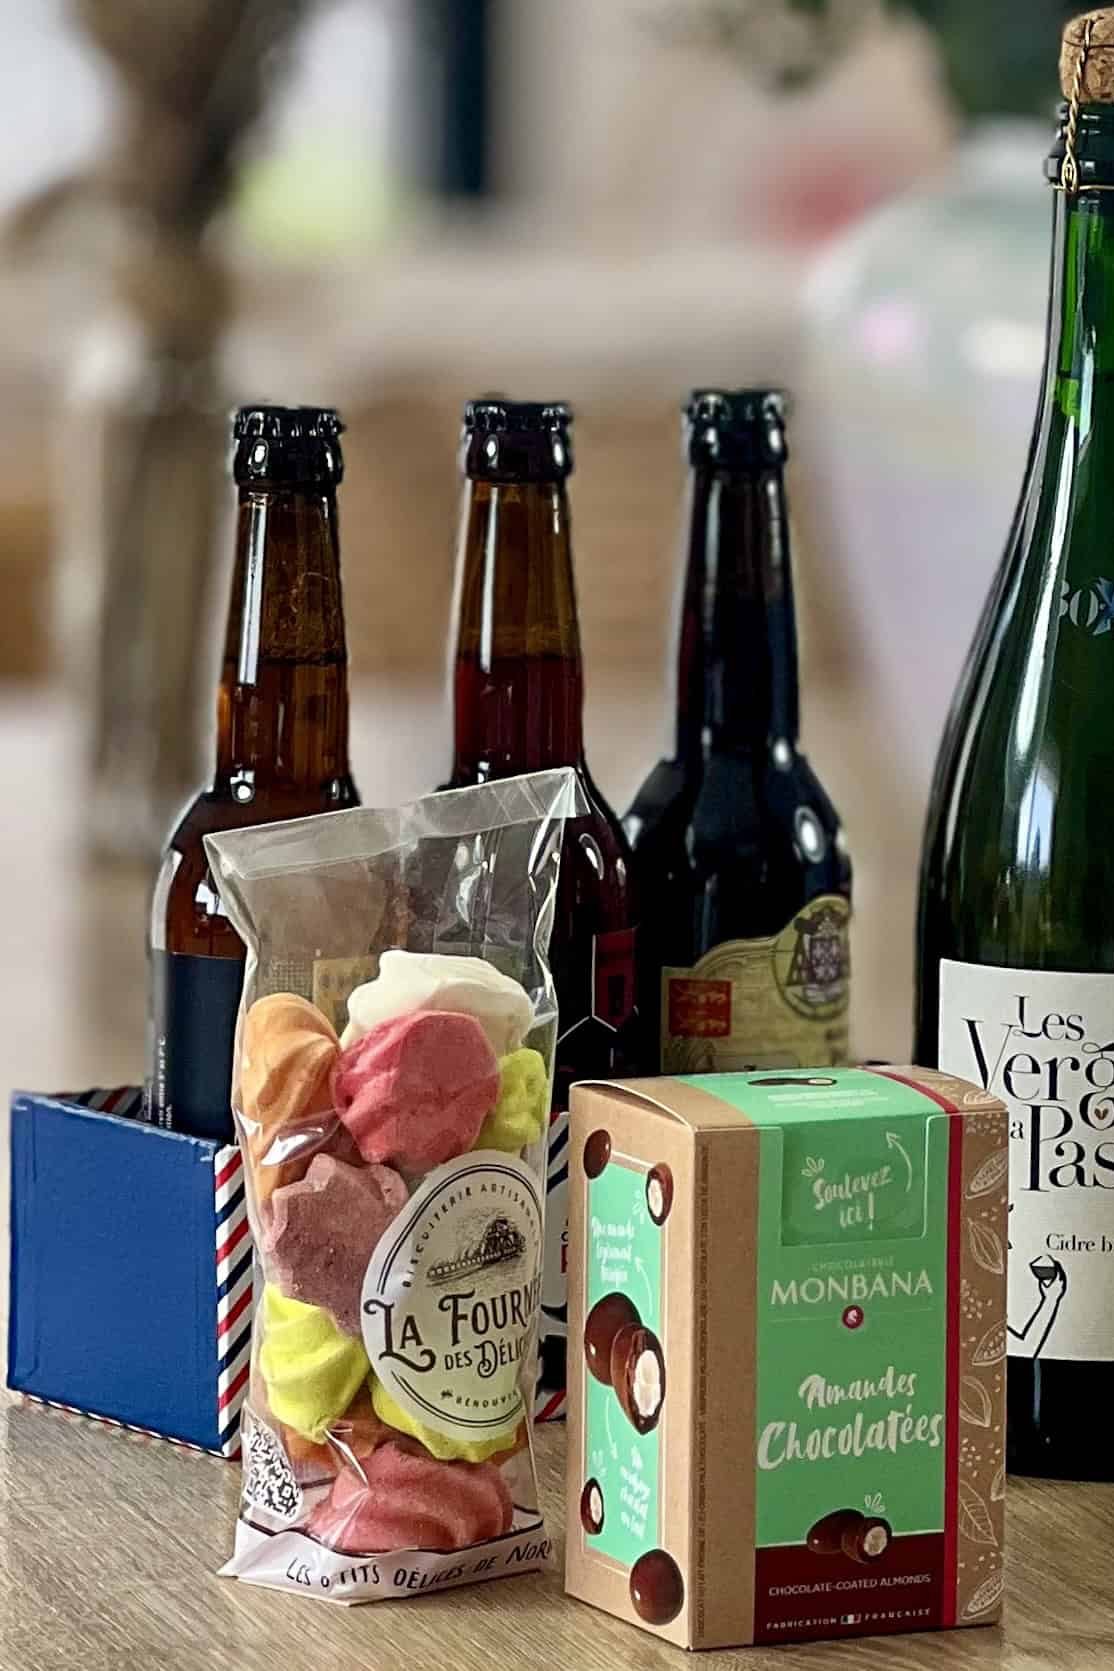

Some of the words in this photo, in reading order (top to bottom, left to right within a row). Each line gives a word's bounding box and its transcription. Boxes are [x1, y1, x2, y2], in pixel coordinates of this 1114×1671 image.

[1015, 994, 1085, 1042] Les
[1009, 1121, 1024, 1141] a
[812, 1164, 893, 1211] Soulevez
[1045, 1232, 1096, 1252] Cidre
[770, 1268, 934, 1305] MONBANA
[362, 1298, 437, 1374] LA
[444, 1350, 474, 1371] DES
[798, 1365, 918, 1411] Amandes
[756, 1403, 945, 1471] Chocolatées
[285, 1556, 312, 1588] LES
[393, 1562, 466, 1589] DÉLICES
[474, 1555, 498, 1574] DE
[505, 1538, 552, 1566] NOR
[768, 1578, 878, 1597] CHOCOLATE-COATED
[880, 1572, 932, 1587] ALMONDS
